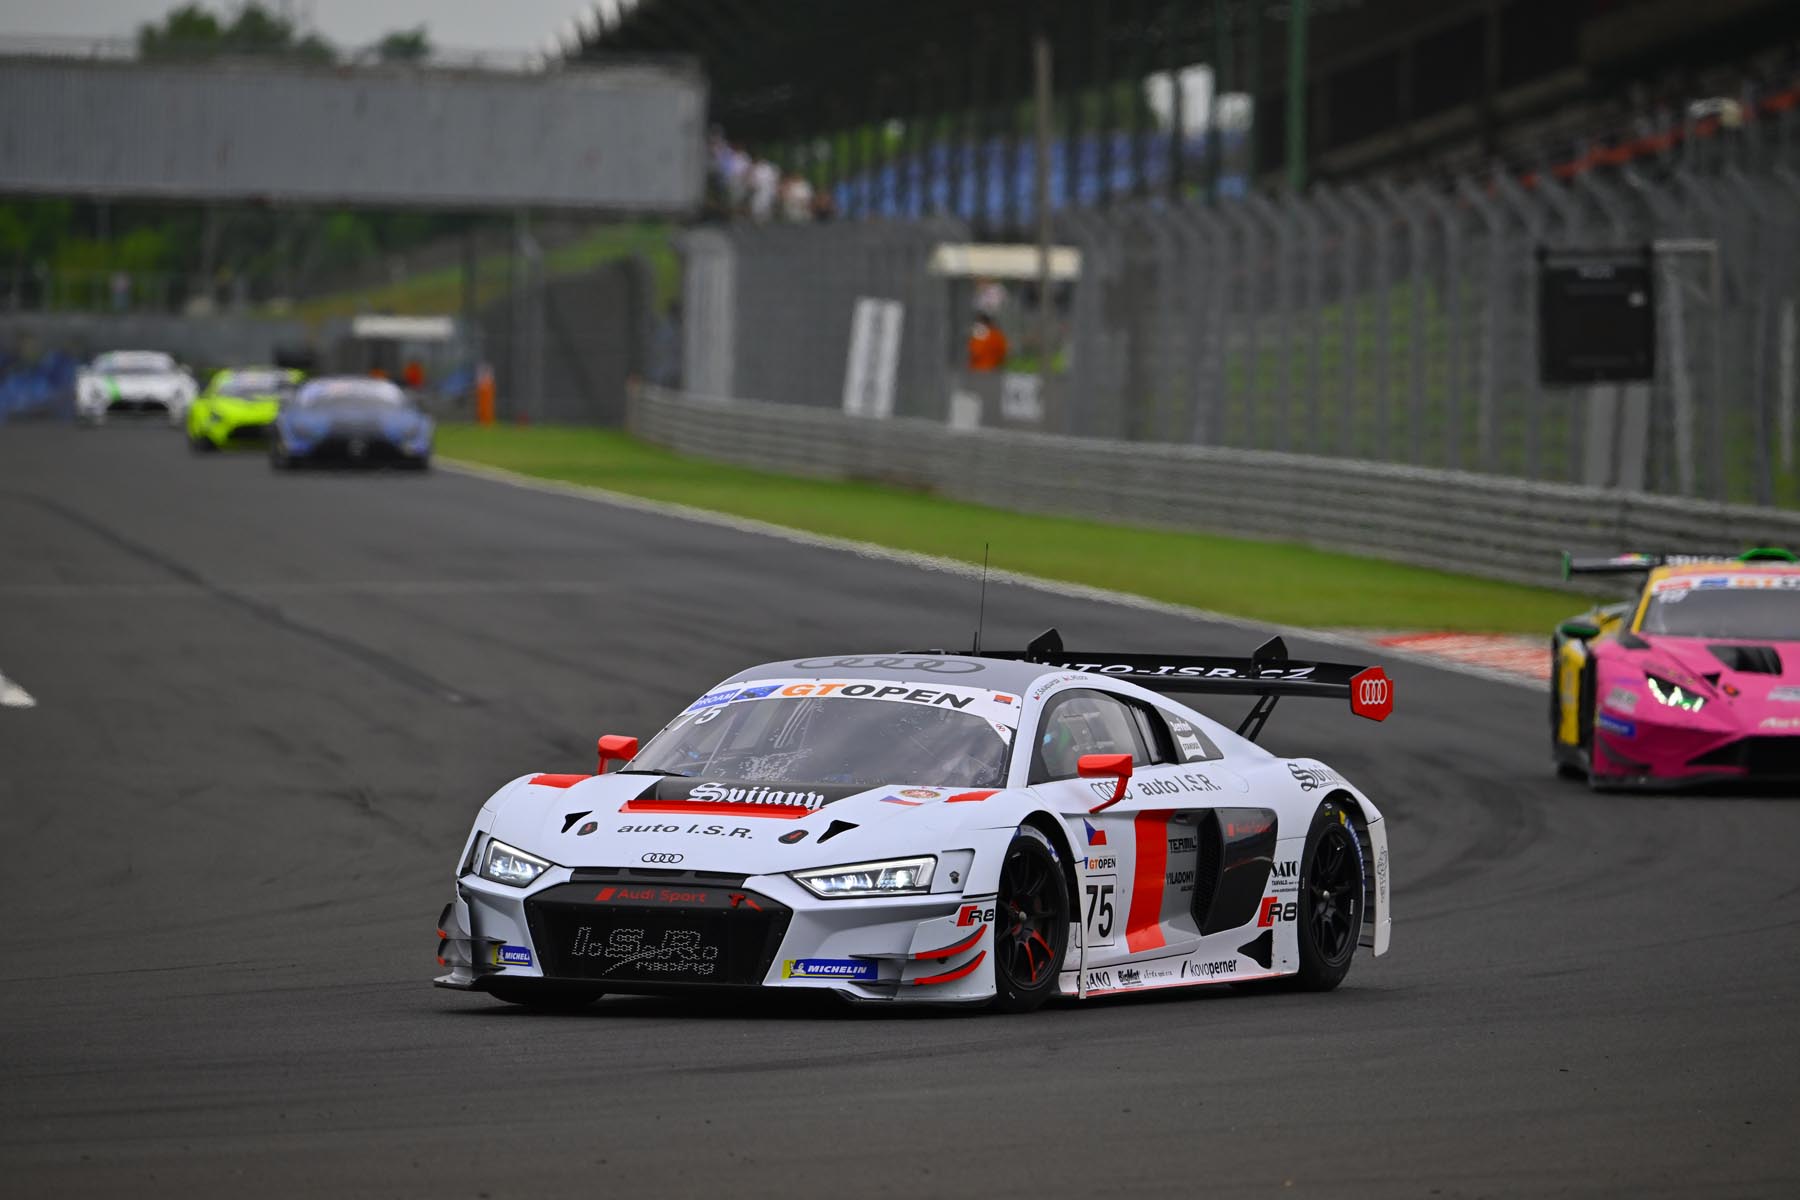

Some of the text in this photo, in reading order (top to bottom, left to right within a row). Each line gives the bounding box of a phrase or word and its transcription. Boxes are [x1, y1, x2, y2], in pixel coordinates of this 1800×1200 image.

[1137, 774, 1222, 796] auto I.S.R.
[617, 823, 753, 839] auto I.S.R.
[617, 888, 706, 904] Audi Sport
[968, 908, 994, 923] R8
[1086, 885, 1114, 938] 75
[1267, 902, 1297, 922] R8
[807, 964, 868, 974] MICHELIN
[1189, 959, 1238, 979] kovoperner
